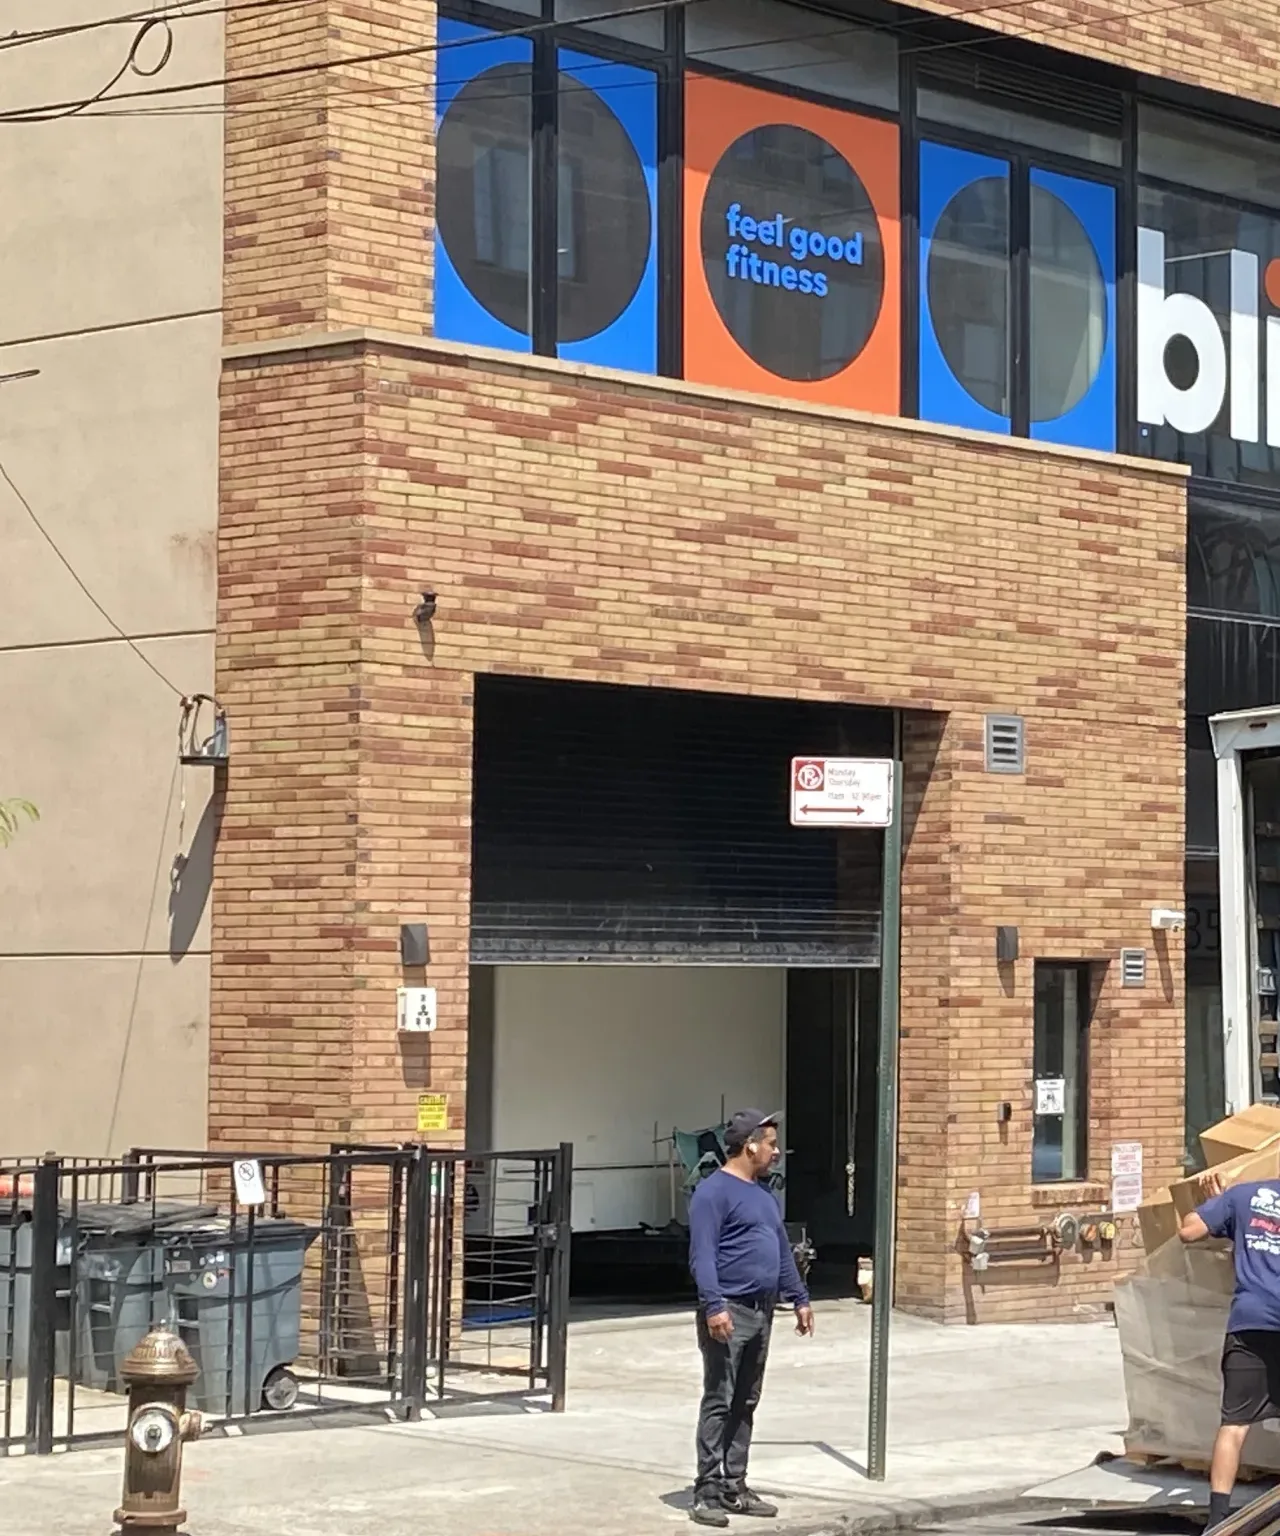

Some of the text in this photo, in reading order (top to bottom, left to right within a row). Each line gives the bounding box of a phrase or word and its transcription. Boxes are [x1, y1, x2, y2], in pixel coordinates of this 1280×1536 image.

[726, 203, 864, 266] feel good
[726, 243, 829, 298] fitness
